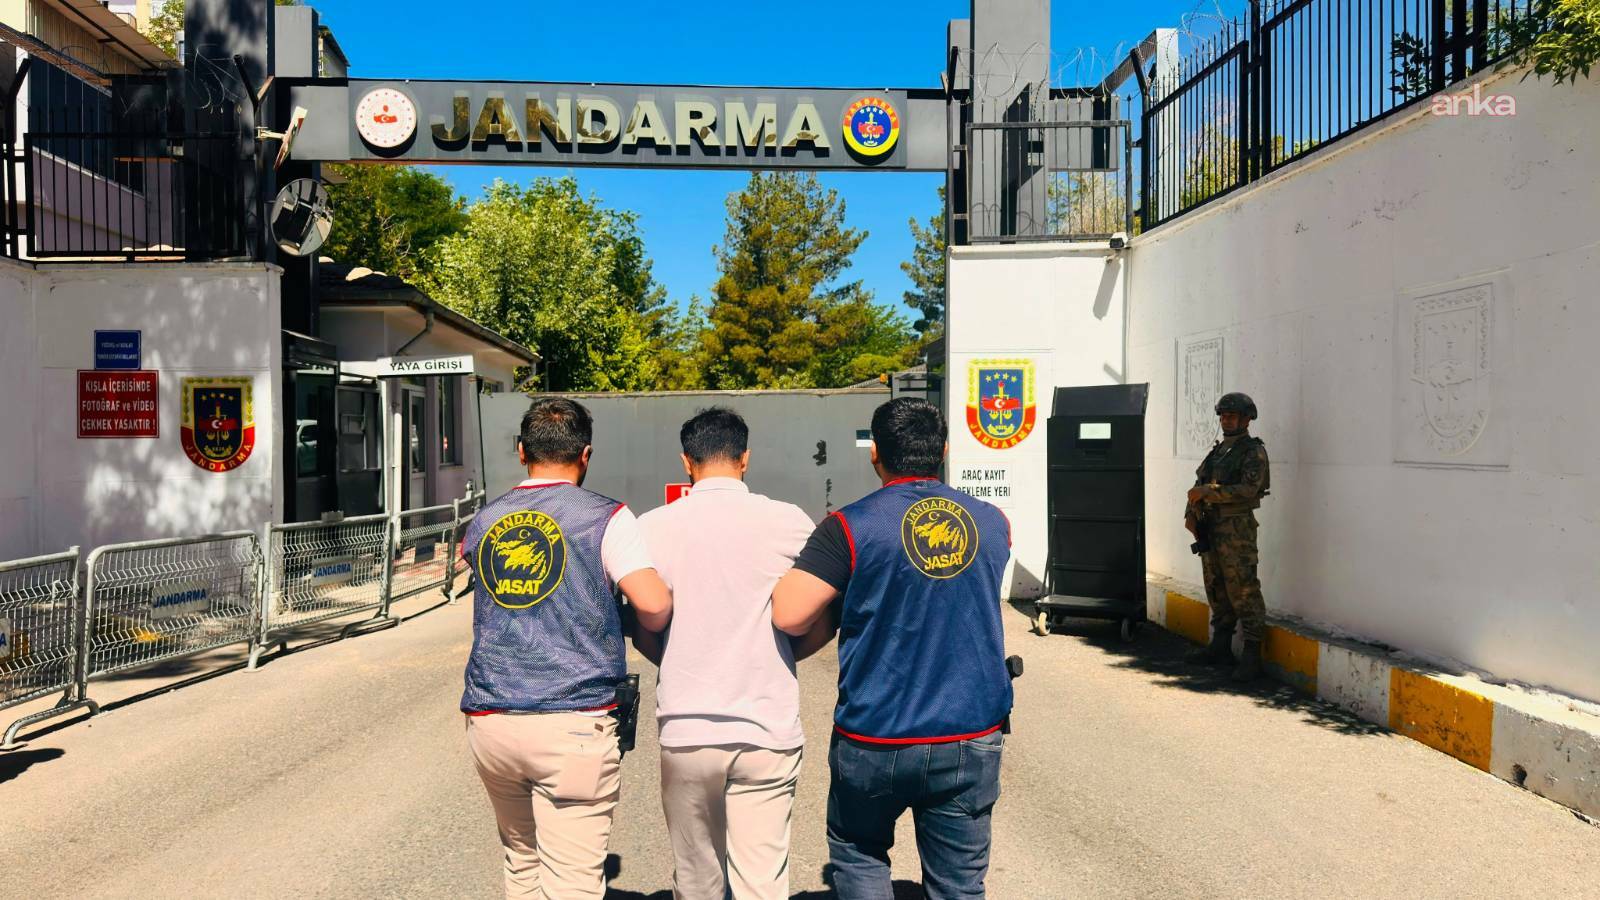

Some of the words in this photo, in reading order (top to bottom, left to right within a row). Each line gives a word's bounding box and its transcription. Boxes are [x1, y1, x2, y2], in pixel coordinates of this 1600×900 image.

[430, 94, 831, 148] JANDARMA
[390, 361, 420, 371] YAYA
[424, 359, 462, 370] GİRİŞİ
[85, 380, 107, 394] KIŞLA
[109, 377, 151, 394] İÇERİSİNDE
[82, 397, 120, 411] FOTOĞRAF
[122, 401, 131, 411] ve
[132, 396, 155, 411] VİDEO
[81, 418, 112, 432] ÇEKMEK
[114, 418, 151, 430] YASAKTIR
[969, 423, 1033, 449] JANDARMA
[186, 444, 252, 470] JANDARMA
[961, 469, 982, 483] ARAÇ
[984, 469, 1006, 481] KAYIT
[906, 500, 963, 524] JANDARMA
[488, 513, 561, 545] JANDARMA
[314, 562, 352, 578] JANDARMA
[924, 551, 964, 571] JASAT
[495, 579, 544, 595] JASAT
[153, 588, 207, 608] JANDARMA
